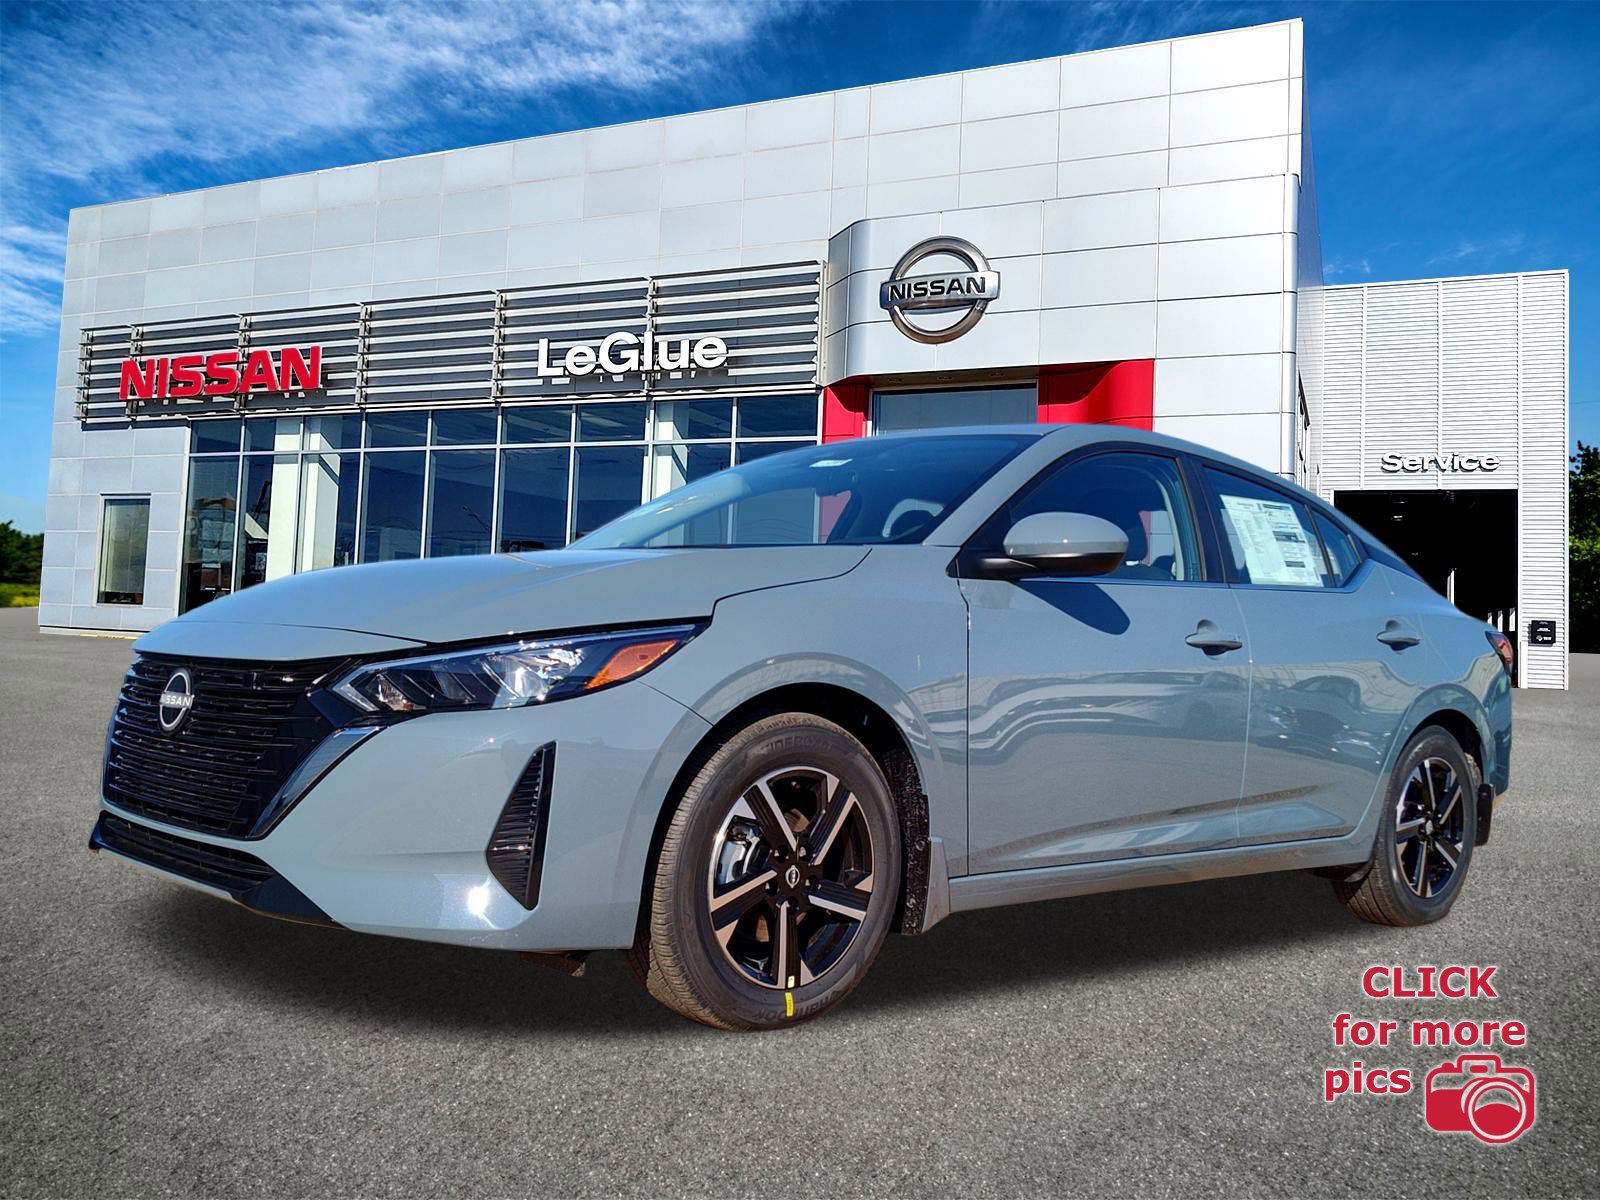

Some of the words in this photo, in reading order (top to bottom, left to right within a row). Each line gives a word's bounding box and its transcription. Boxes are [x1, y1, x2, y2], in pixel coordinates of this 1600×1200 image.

[889, 276, 986, 302] NISSAN
[537, 331, 729, 379] LeGlue
[119, 344, 323, 402] NISSAN
[1381, 450, 1501, 473] Service
[161, 694, 191, 707] SSAN
